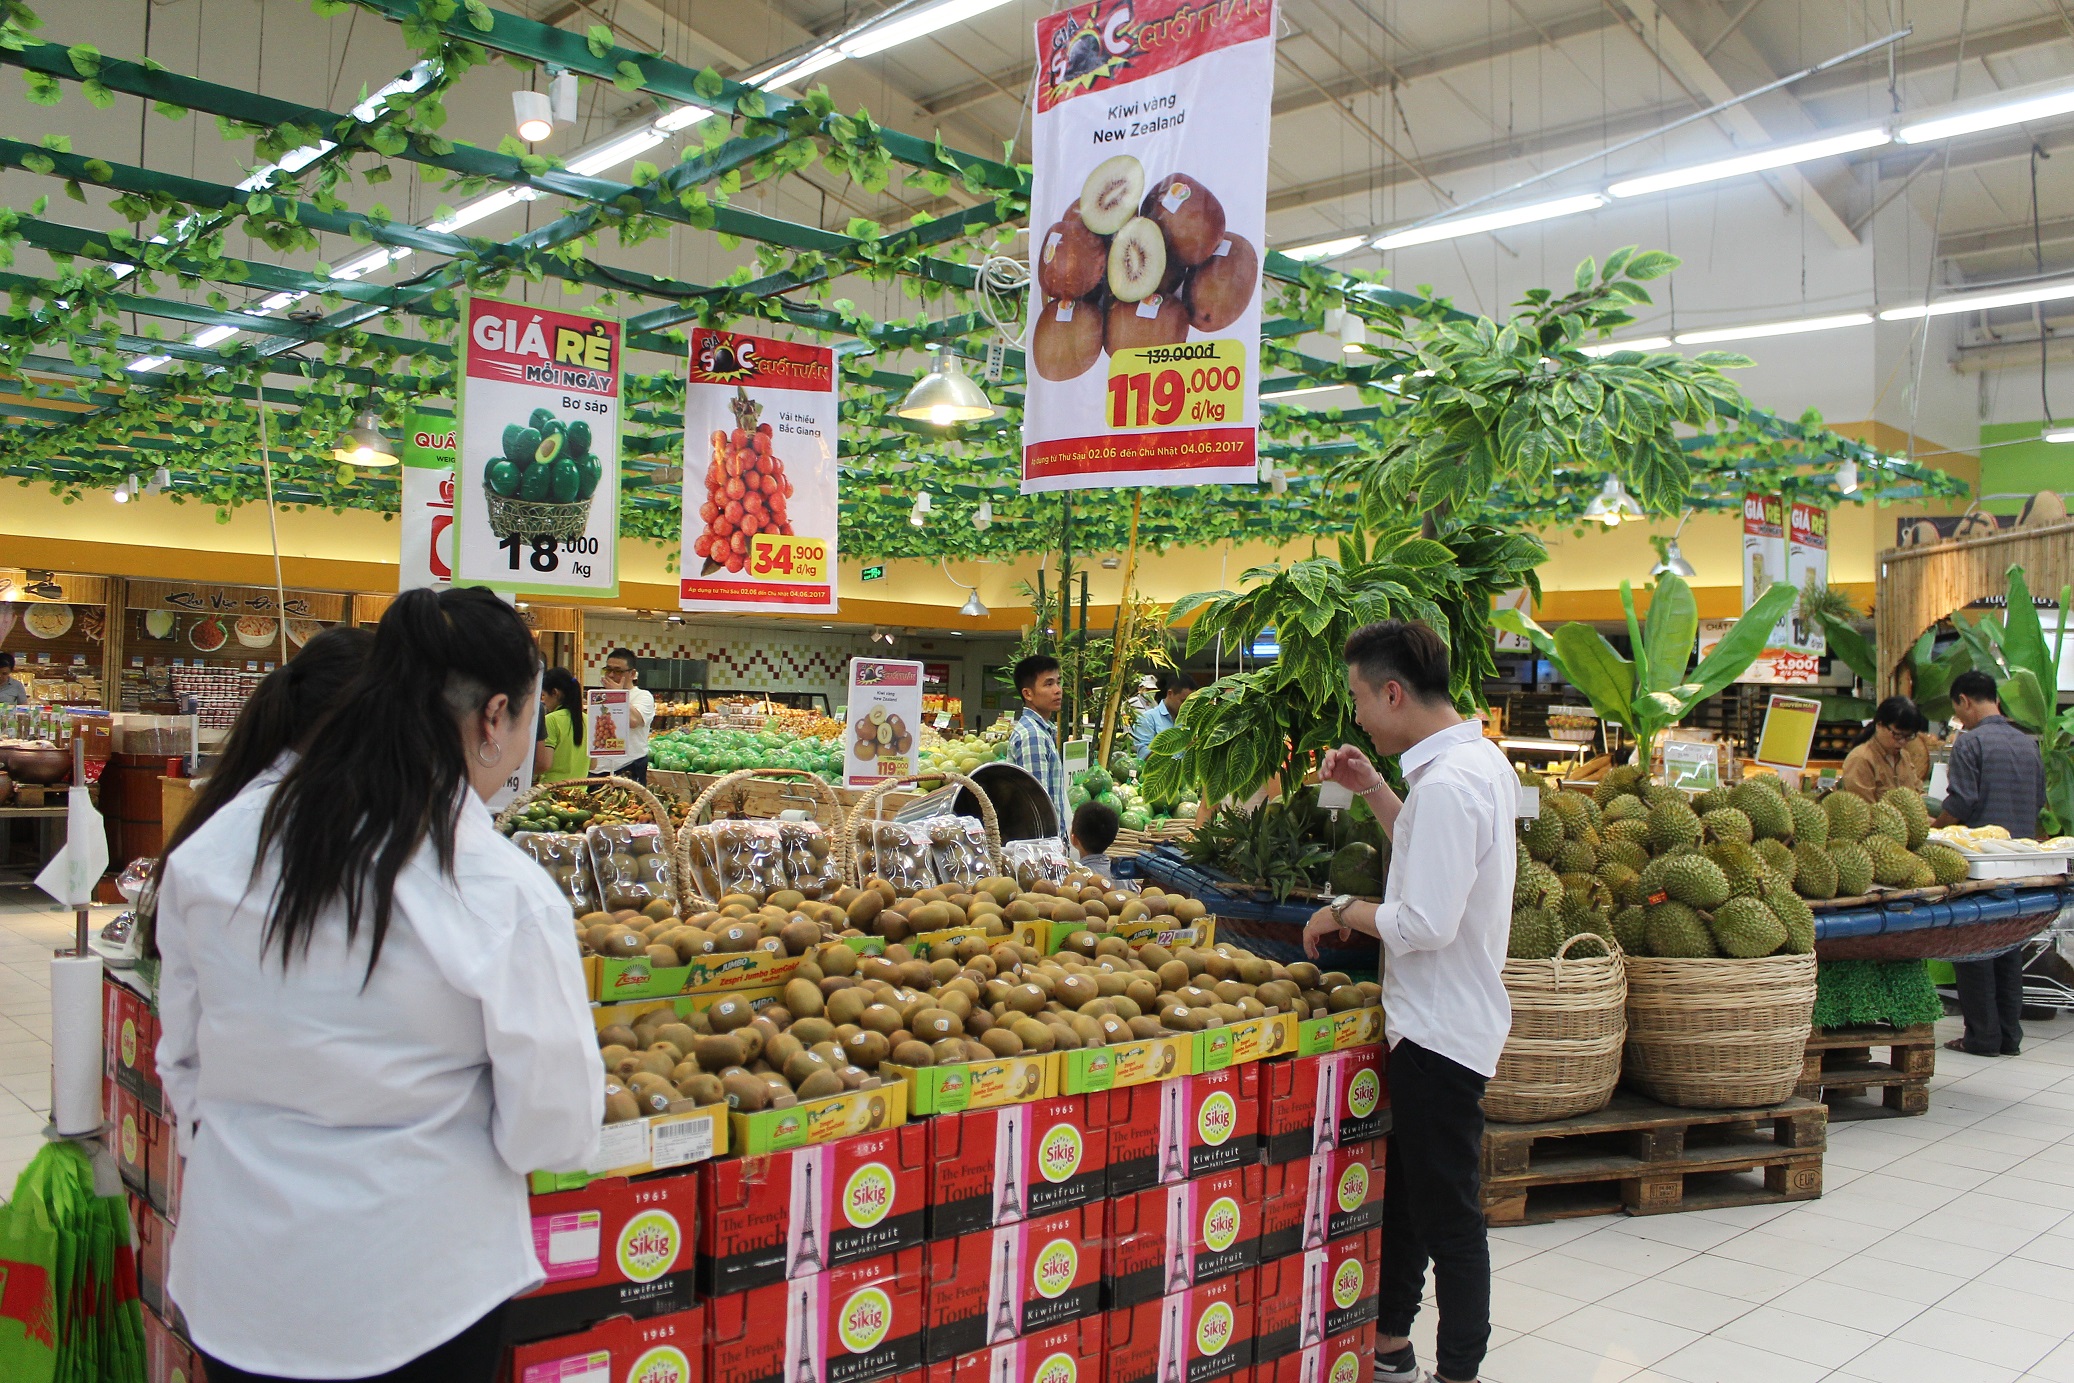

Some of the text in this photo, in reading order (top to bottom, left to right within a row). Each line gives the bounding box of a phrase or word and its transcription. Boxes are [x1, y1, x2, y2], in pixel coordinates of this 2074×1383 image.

[1107, 93, 1177, 121] Kiwi vàng
[1093, 110, 1185, 145] New Zealand
[473, 315, 613, 373] GIÁ RẺ
[525, 362, 613, 393] MỖI NGÀY
[562, 396, 608, 415] Bơ sáp
[1191, 399, 1226, 422] đ/kg
[779, 411, 793, 421] Vải
[779, 423, 821, 438] Bắc Giang
[1088, 447, 1117, 459] 02.06
[1180, 441, 1244, 455] 04.06.2017
[1792, 508, 1810, 531] GIÁ
[571, 562, 591, 577] /kg
[796, 563, 817, 577] đ/kg
[1159, 932, 1173, 945] 22
[722, 957, 749, 973] JUMBO
[720, 974, 743, 986] Zespri
[744, 970, 768, 982] Jumbo
[1357, 1053, 1375, 1062] 1965
[1208, 1075, 1228, 1085] 1965
[1354, 1086, 1374, 1102] Sikig
[1050, 1105, 1074, 1116] 1965
[1205, 1111, 1230, 1128] Sikig
[1277, 1111, 1314, 1133] Touch
[1046, 1143, 1075, 1163] Sikig
[1113, 1139, 1159, 1162] Touch
[1193, 1147, 1239, 1165] Kiwifruit
[1347, 1148, 1364, 1157] 1965
[941, 1176, 994, 1202] Touch
[1213, 1180, 1233, 1191] 1965
[1343, 1179, 1363, 1196] Sikig
[1800, 1173, 1818, 1186] EUR
[636, 1190, 668, 1203] 1965
[852, 1185, 887, 1206] Sikig
[1032, 1184, 1085, 1203] Kiwifruit
[1046, 1220, 1069, 1233] 1965
[1210, 1214, 1234, 1233] Sikig
[1267, 1211, 1304, 1233] Touch
[627, 1234, 670, 1257] Sikig
[722, 1224, 787, 1257] Touch
[835, 1228, 899, 1251] Kiwifruit
[1041, 1258, 1070, 1278] Sikig
[1119, 1250, 1165, 1276] Touch
[1198, 1252, 1243, 1271] Kiwifruit
[852, 1266, 880, 1280] 1965
[620, 1281, 674, 1297] Kiwifruit
[1207, 1284, 1228, 1297] 1965
[1338, 1275, 1358, 1291] Sikig
[935, 1298, 988, 1326] Touch
[1027, 1297, 1080, 1320] Kiwifruit
[848, 1310, 882, 1331] Sikig
[1203, 1318, 1227, 1338] Sikig
[1264, 1311, 1301, 1335] Touch
[643, 1326, 675, 1341] 1965
[1045, 1334, 1068, 1348] 1965
[1338, 1335, 1355, 1348] 1965
[720, 1357, 785, 1383] Touch
[832, 1352, 896, 1378] Kiwifruit
[1113, 1358, 1159, 1383] Touch
[1190, 1353, 1236, 1377] Kiwifruit
